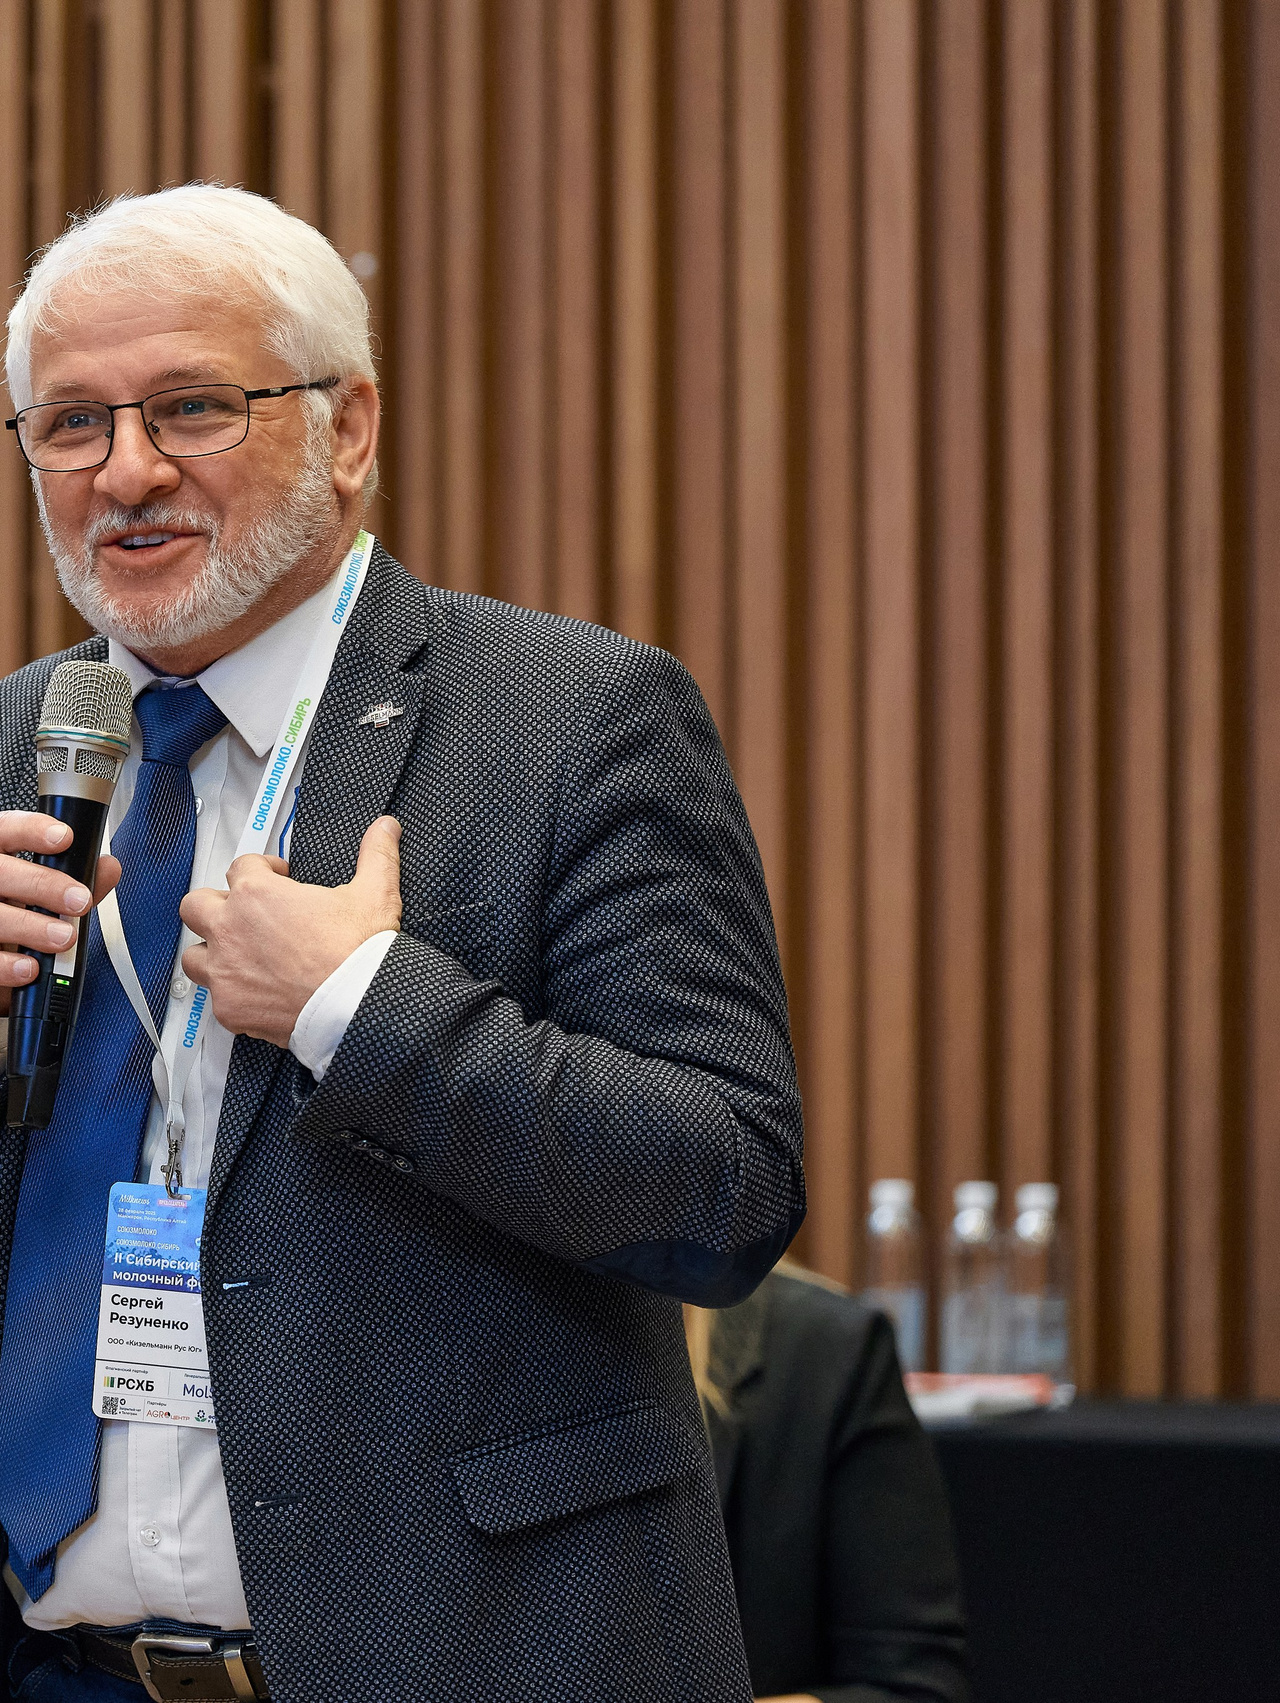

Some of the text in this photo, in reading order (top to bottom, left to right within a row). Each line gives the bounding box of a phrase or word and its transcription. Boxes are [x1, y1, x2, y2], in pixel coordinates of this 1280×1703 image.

[117, 1225, 157, 1236] СОЮЗМОЛОКО
[114, 1252, 122, 1263] II
[113, 1270, 183, 1287] молочный
[111, 1293, 163, 1310] Сергей
[109, 1311, 189, 1331] Резуненко
[107, 1337, 203, 1353] ООО «Кизельманн Рус Юг»
[117, 1377, 154, 1392] РСХБ
